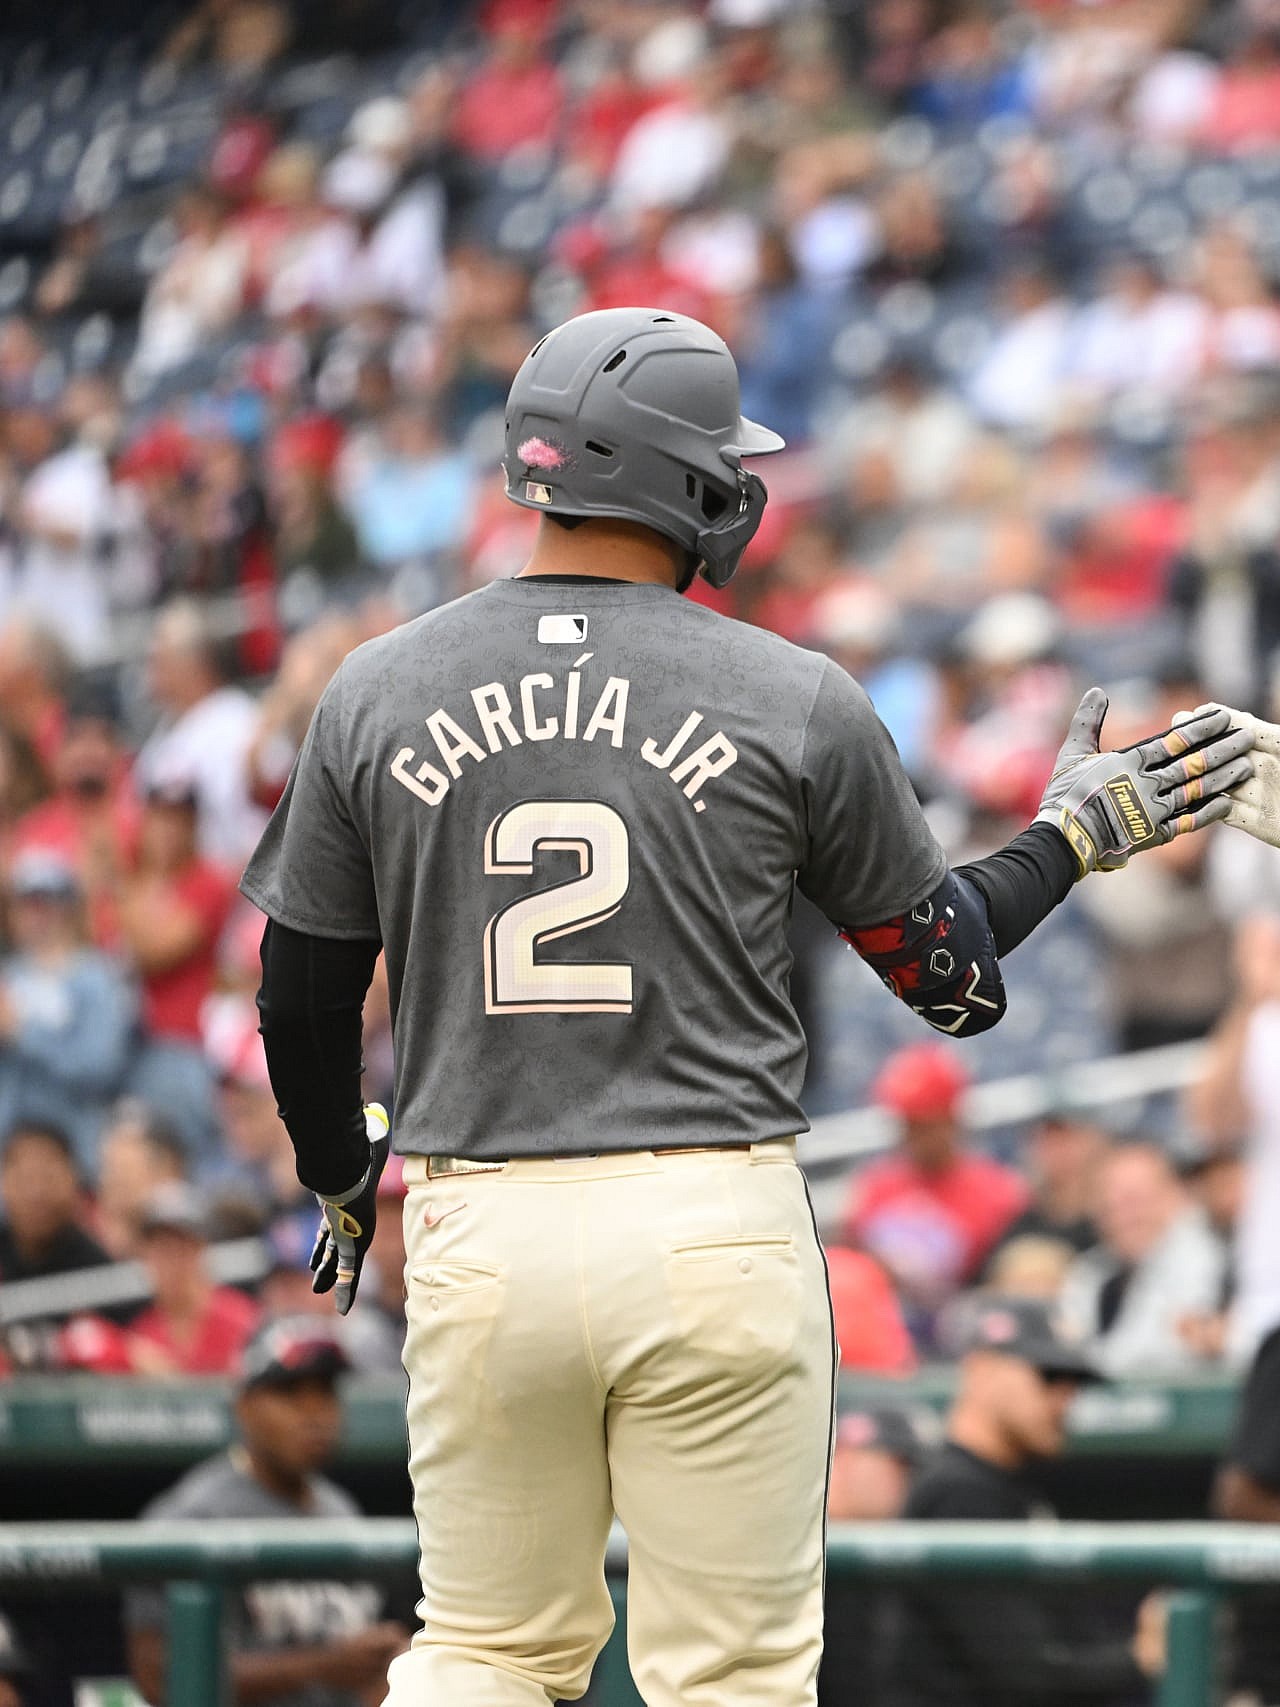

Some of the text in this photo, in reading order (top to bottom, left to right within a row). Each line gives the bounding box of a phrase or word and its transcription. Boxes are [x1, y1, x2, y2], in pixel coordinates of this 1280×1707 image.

[390, 652, 738, 813] GARCÍA JR.
[1107, 780, 1147, 839] Franklin
[484, 798, 633, 1015] 2
